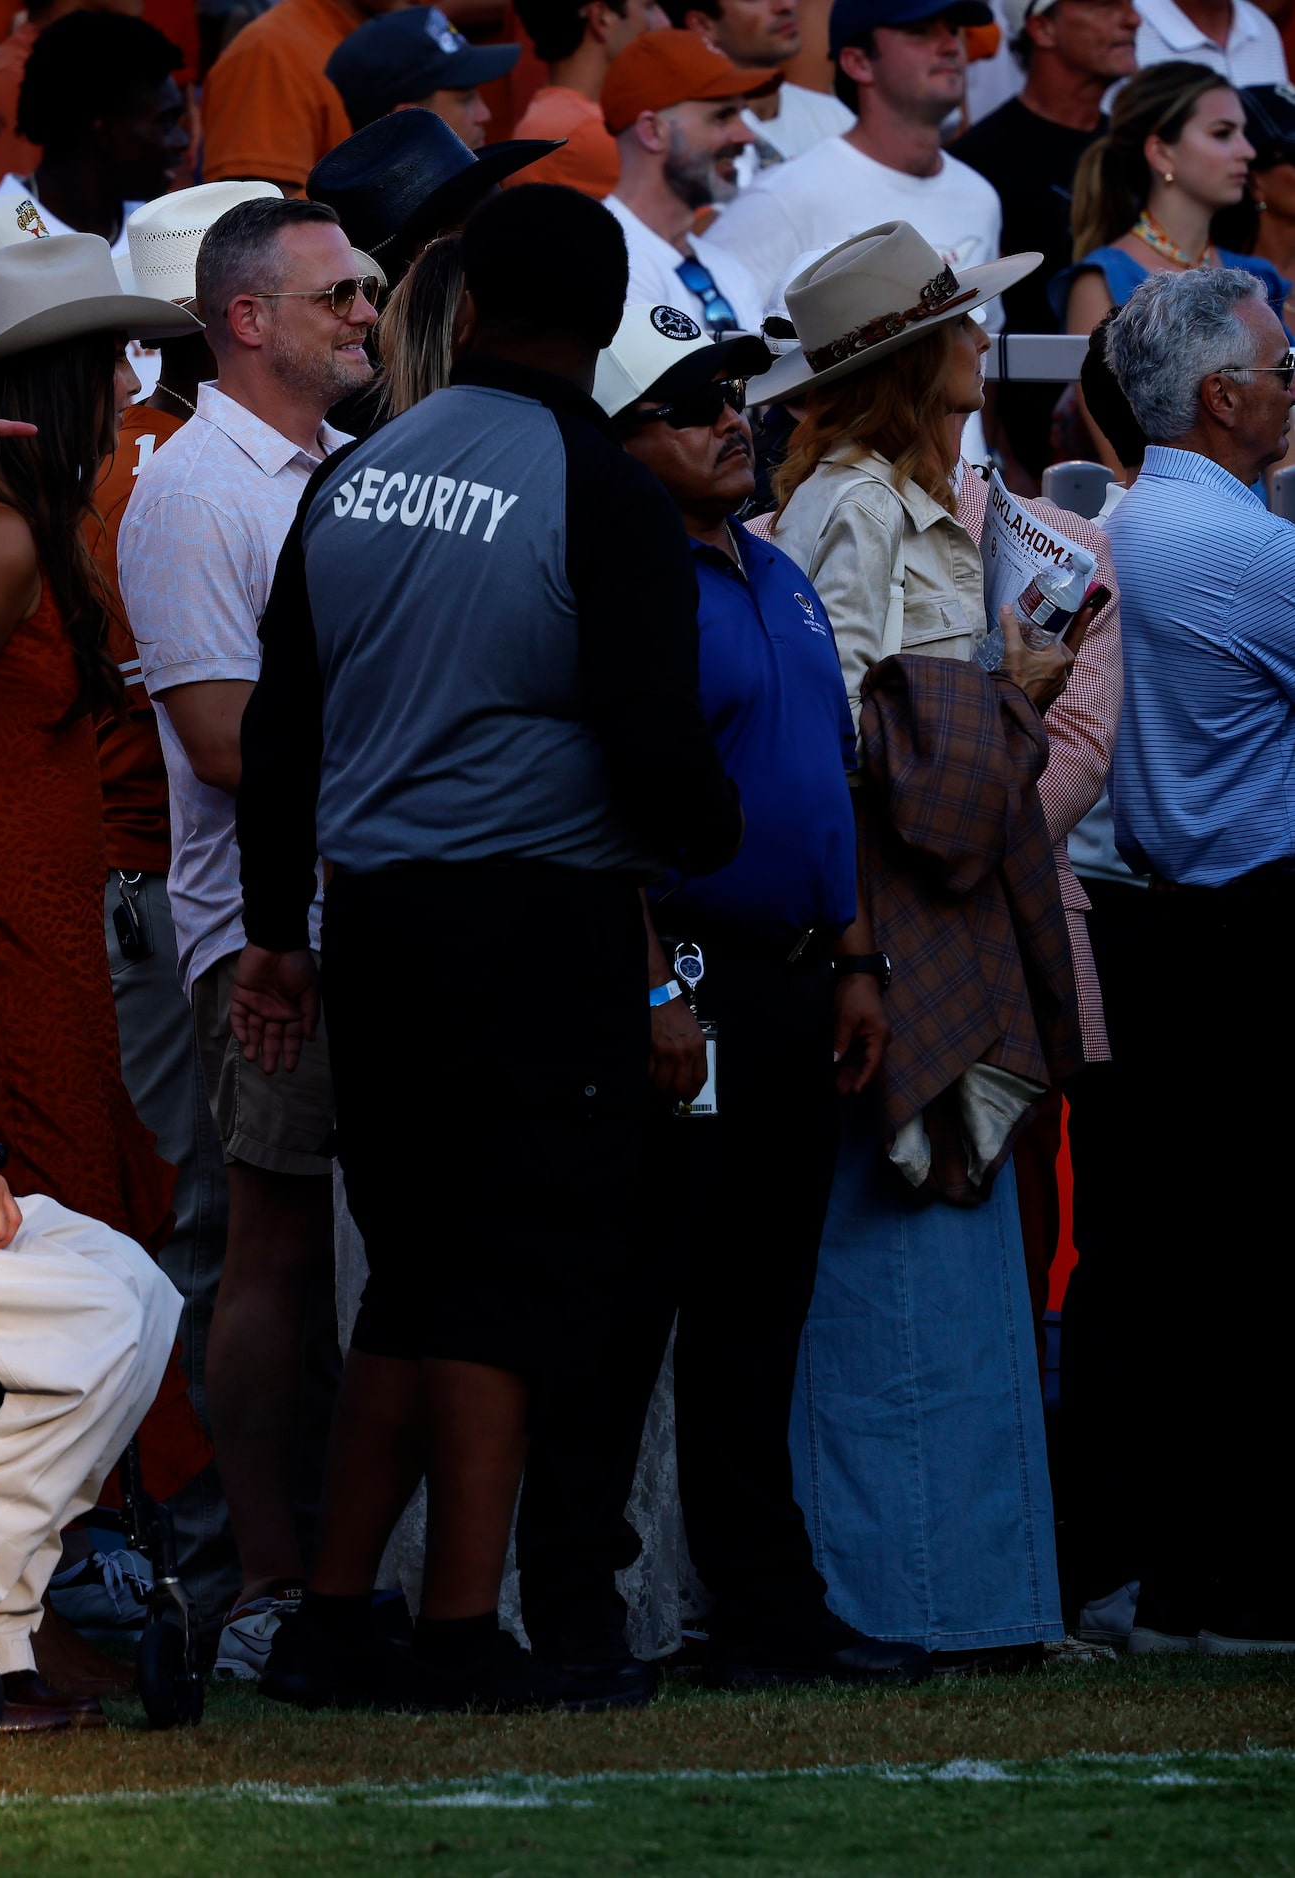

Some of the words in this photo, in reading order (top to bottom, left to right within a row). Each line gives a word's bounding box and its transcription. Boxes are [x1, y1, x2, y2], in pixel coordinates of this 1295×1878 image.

[333, 467, 520, 543] SECURITY
[1005, 527, 1039, 560] FOOTBALL
[283, 1588, 303, 1599] TEX
